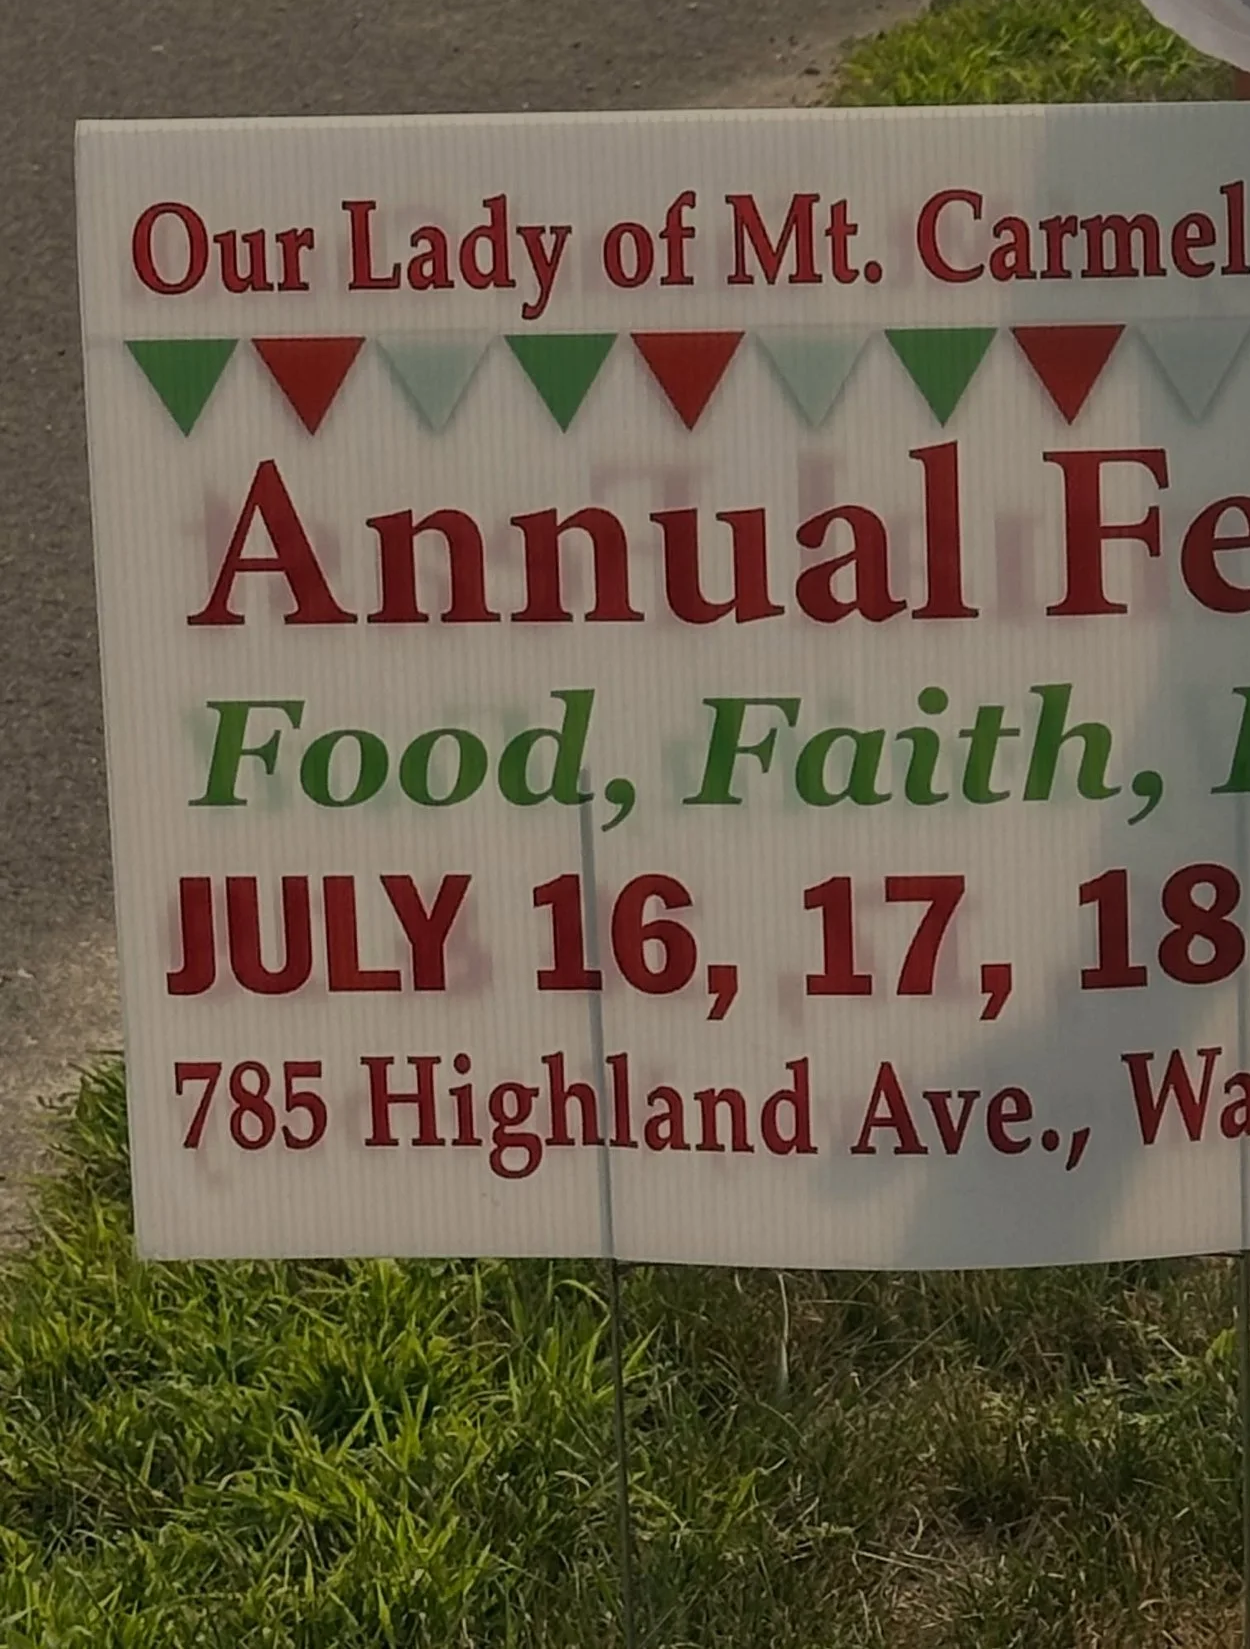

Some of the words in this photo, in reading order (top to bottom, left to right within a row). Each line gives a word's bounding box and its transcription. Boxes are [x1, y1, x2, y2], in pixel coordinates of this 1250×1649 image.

[132, 202, 314, 295] Our
[348, 194, 572, 320] Lady
[604, 191, 696, 288] of
[725, 193, 882, 285] Mt.
[187, 440, 979, 626] Annual
[188, 689, 635, 832] Food,
[683, 683, 1163, 825] Faith,
[167, 874, 472, 995] JULY
[533, 873, 738, 1020] 16,
[804, 875, 1012, 1020] 17,
[1079, 864, 1245, 990] 18
[175, 1061, 327, 1150] 785
[360, 1052, 818, 1179] Highland
[850, 1061, 1090, 1171] Ave.,
